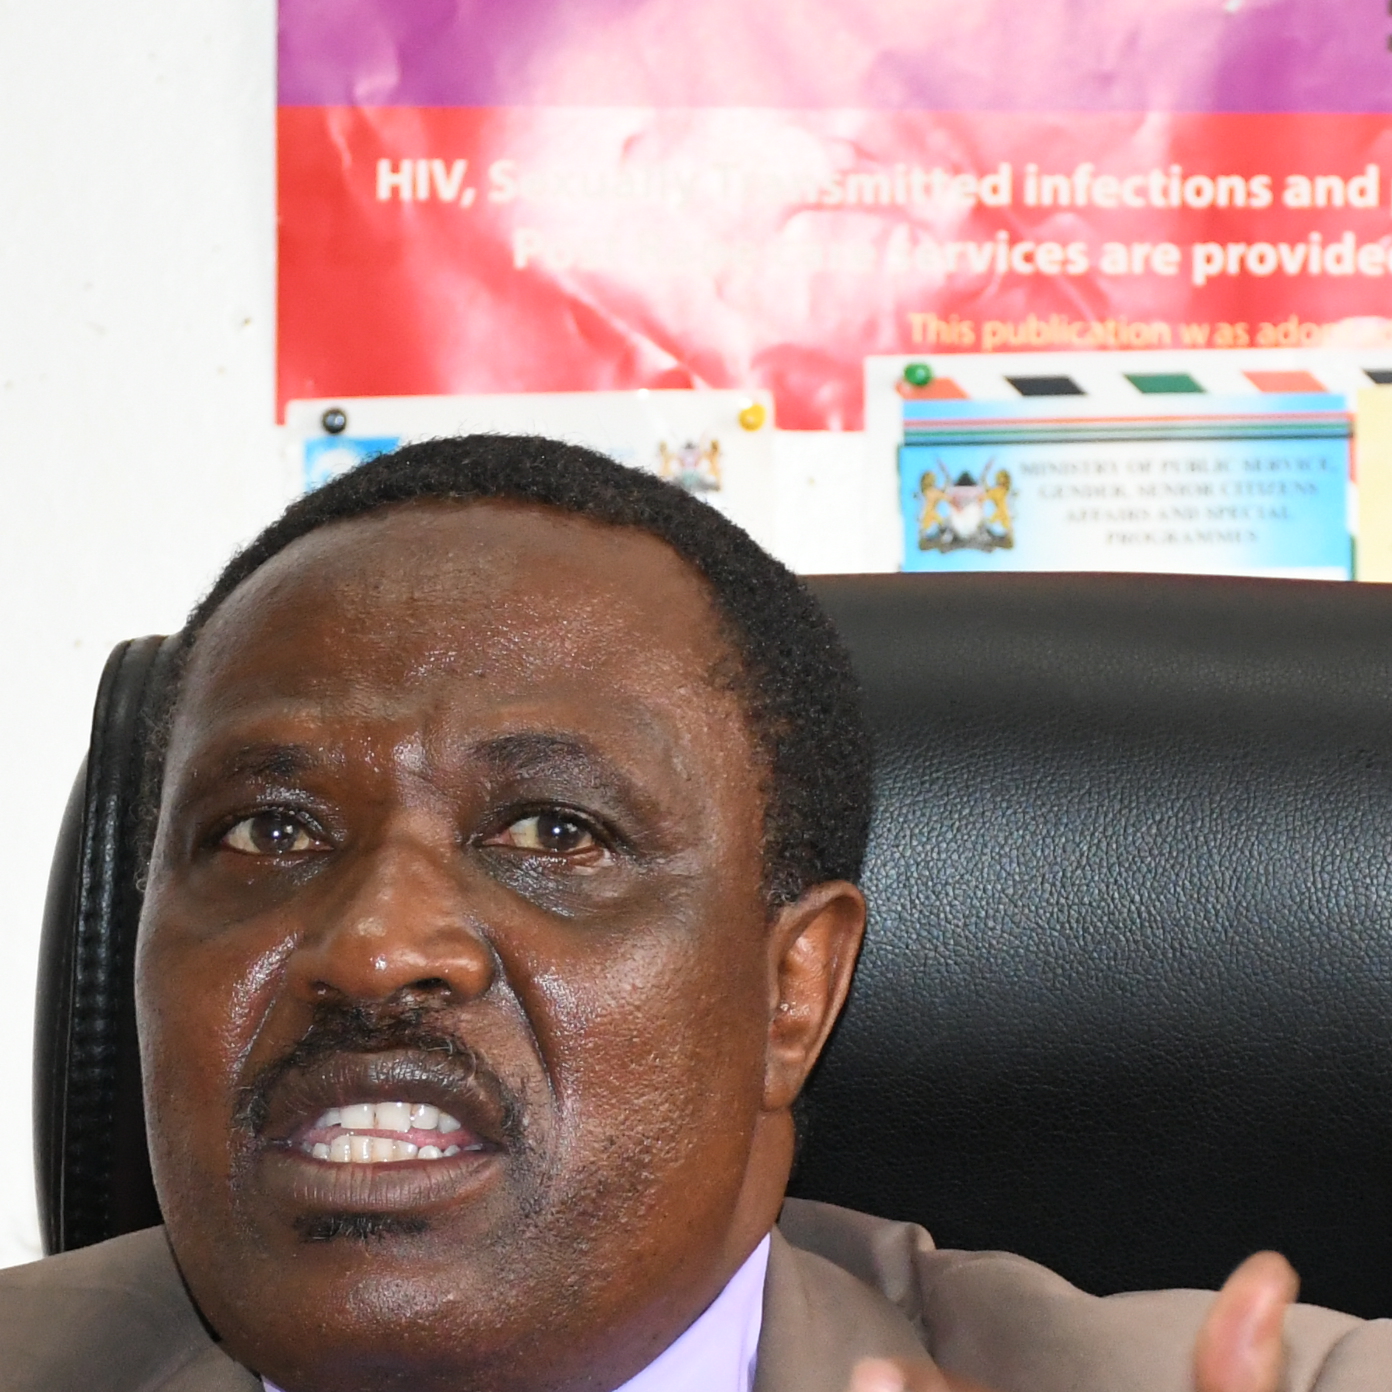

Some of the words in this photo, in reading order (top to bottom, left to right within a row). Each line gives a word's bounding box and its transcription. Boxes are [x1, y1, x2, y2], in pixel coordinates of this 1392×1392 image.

[375, 157, 476, 208] HIV,
[1023, 163, 1273, 208] infections
[1282, 163, 1380, 208] and
[887, 230, 1090, 275] services
[1099, 240, 1181, 275] are
[910, 312, 976, 346] This
[981, 312, 1172, 351] publication
[1179, 319, 1251, 347] was
